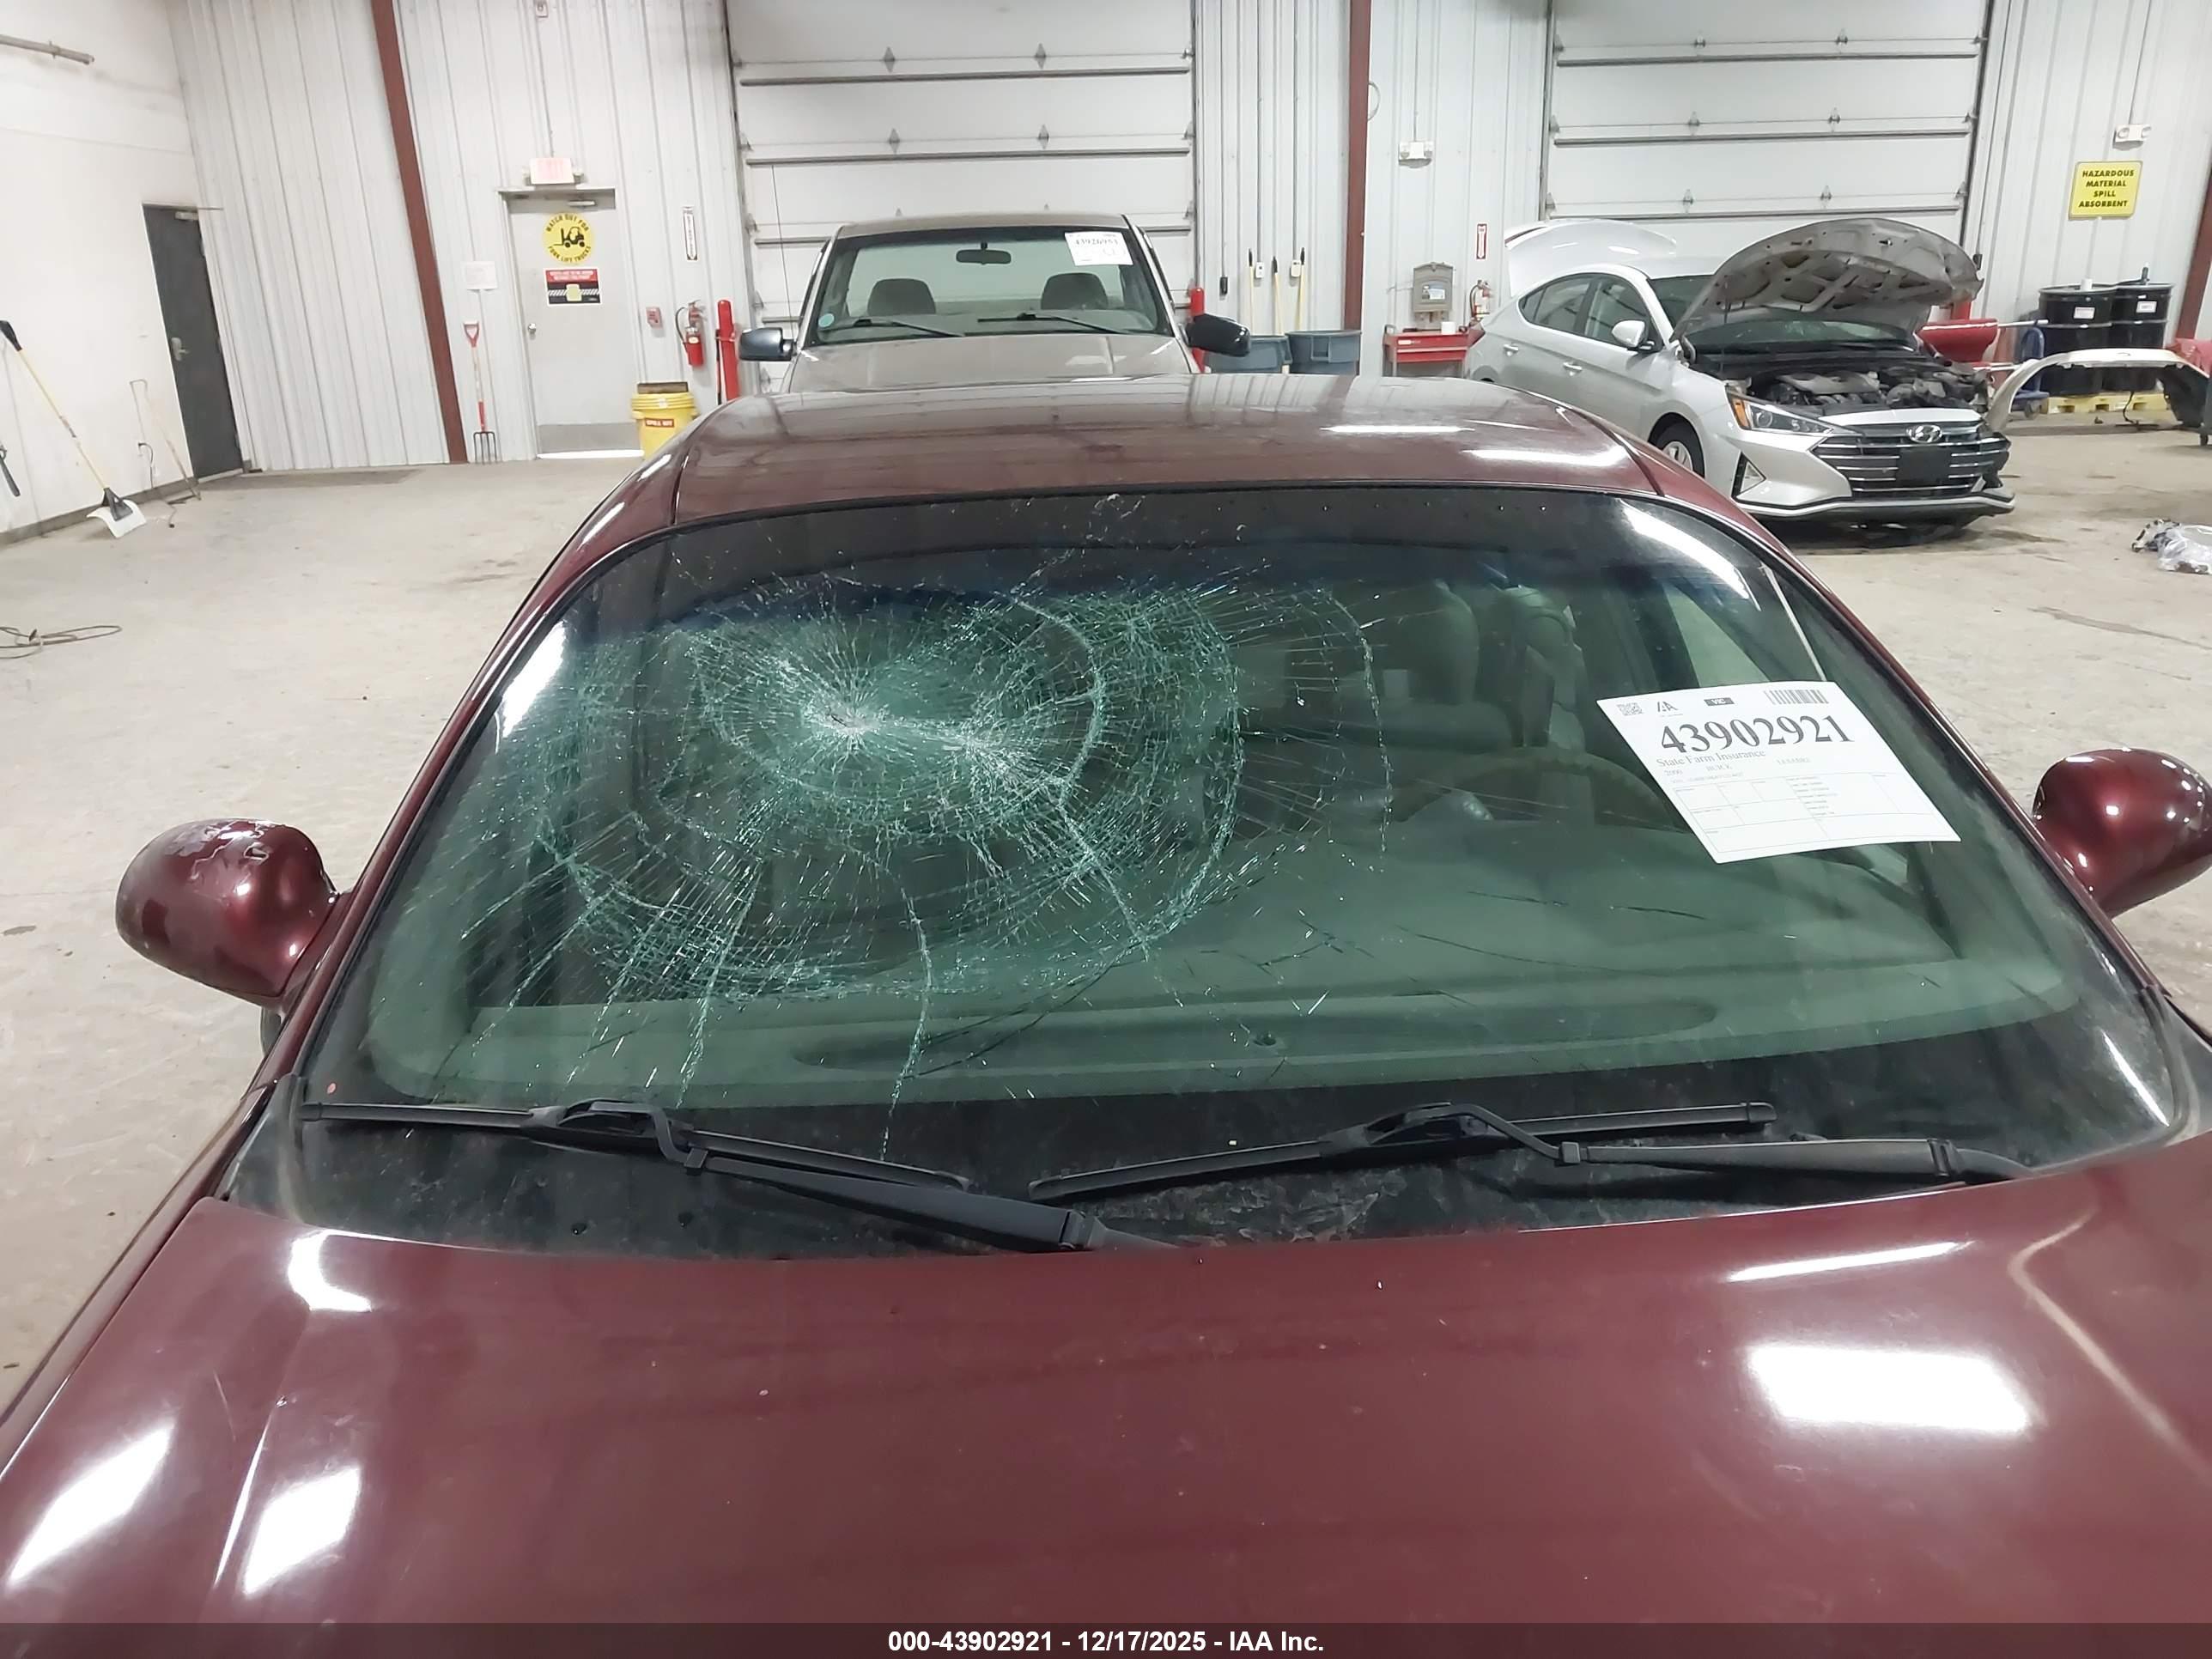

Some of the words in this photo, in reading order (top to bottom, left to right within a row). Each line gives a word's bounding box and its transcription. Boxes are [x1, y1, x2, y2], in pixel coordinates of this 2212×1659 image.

[545, 215, 563, 232] WATCH
[564, 213, 578, 222] OUT
[578, 219, 589, 231] FOR
[547, 246, 561, 259] FORK
[574, 245, 592, 263] TRUCKS
[1661, 714, 1855, 754] 43902921
[1656, 756, 1685, 768] State
[1686, 752, 1715, 764] Farm
[1716, 749, 1766, 762] Insurance
